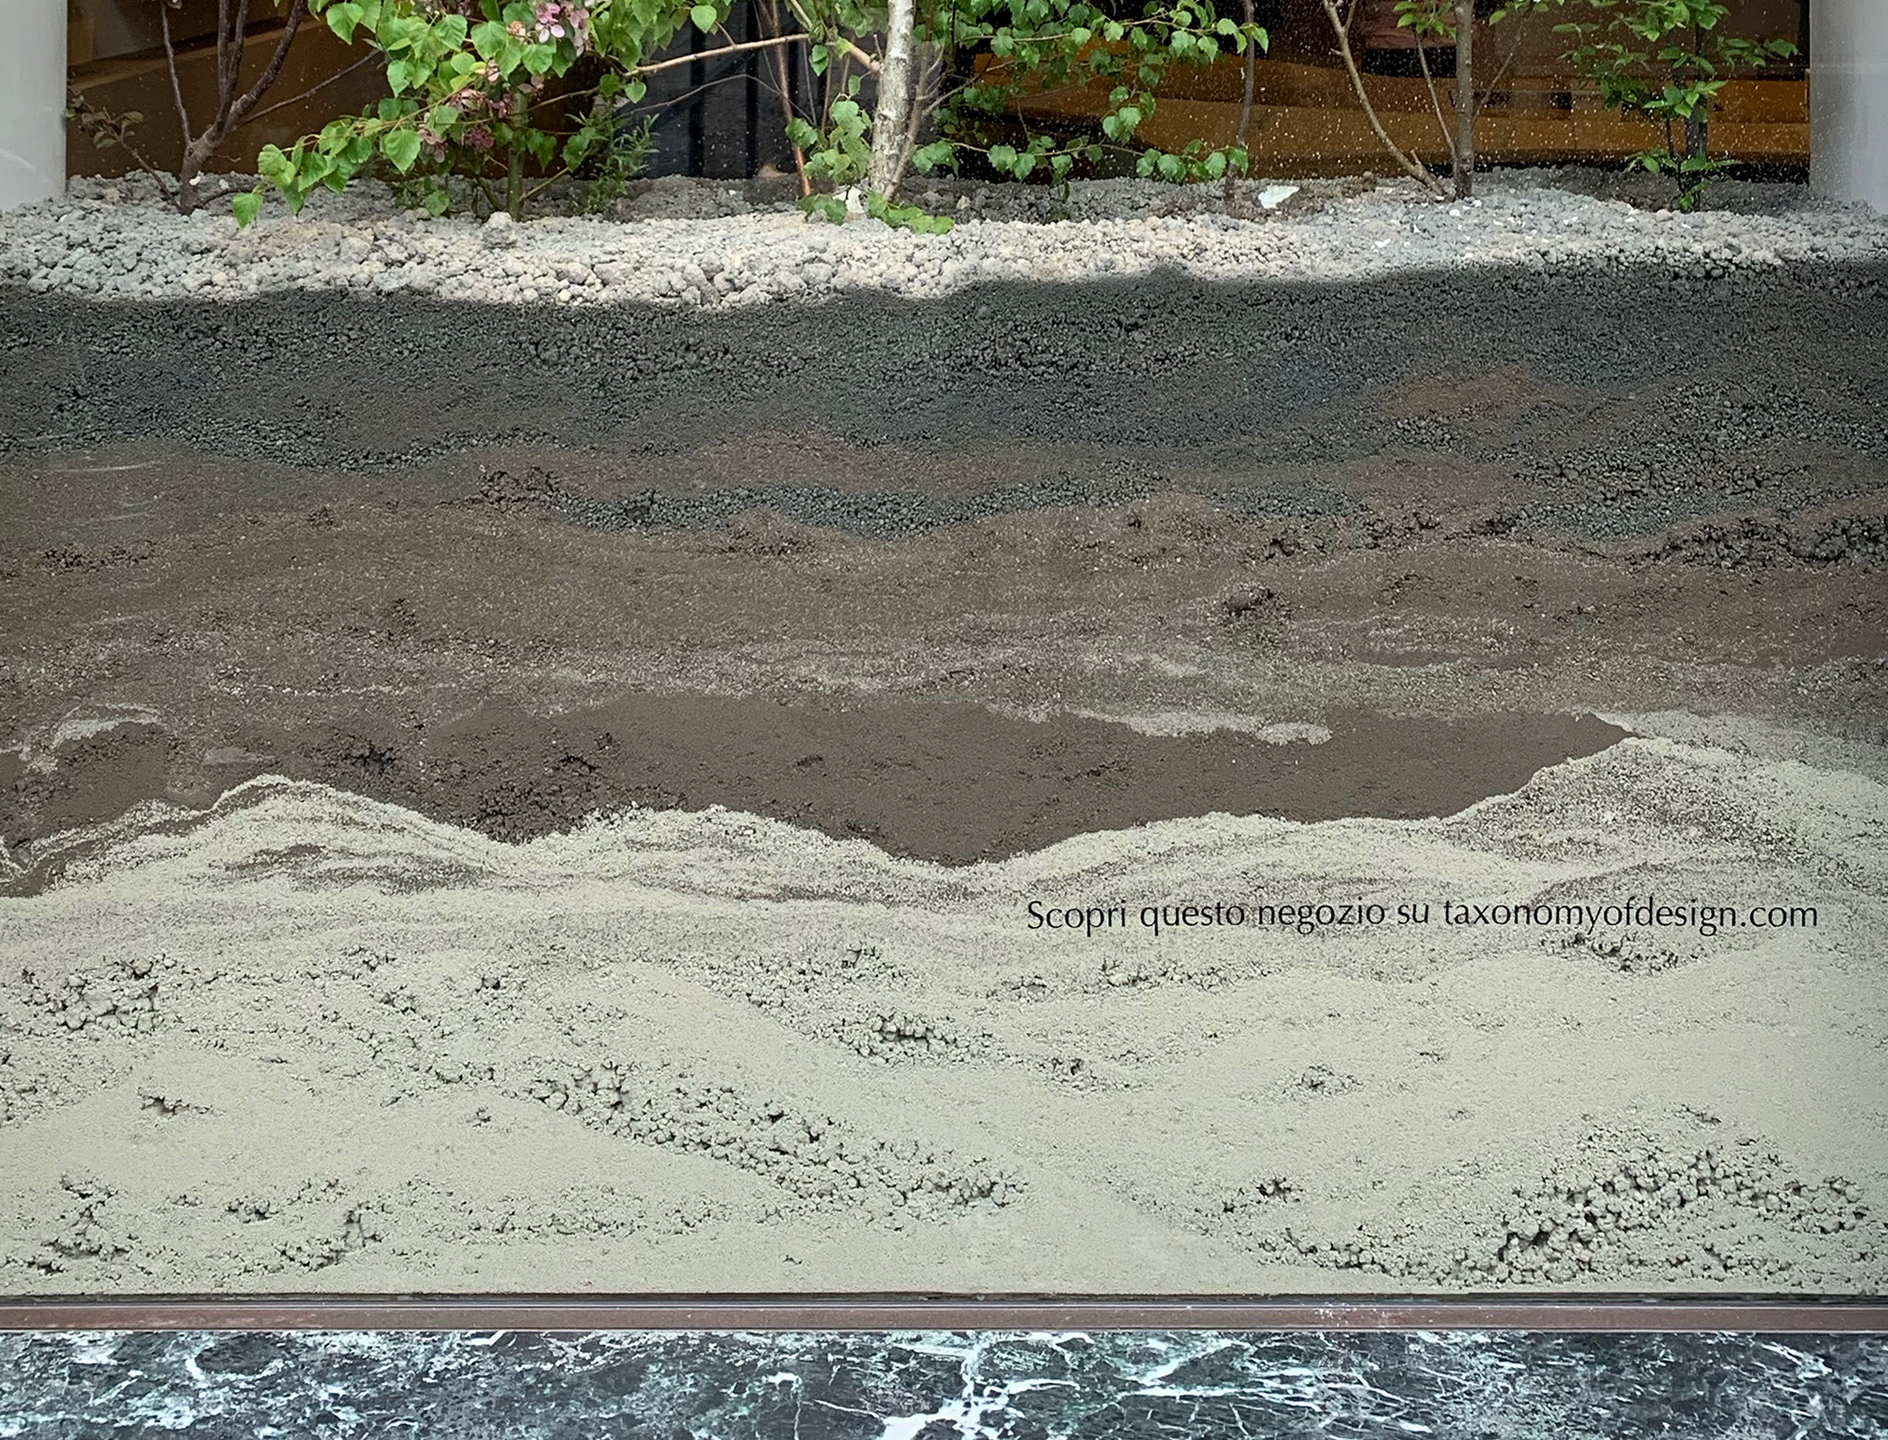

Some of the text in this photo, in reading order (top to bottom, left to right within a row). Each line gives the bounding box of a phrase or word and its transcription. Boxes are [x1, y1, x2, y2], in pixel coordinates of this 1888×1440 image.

[1028, 896, 1818, 937] Scopri questo negozio su taxonomyofdesign.com
